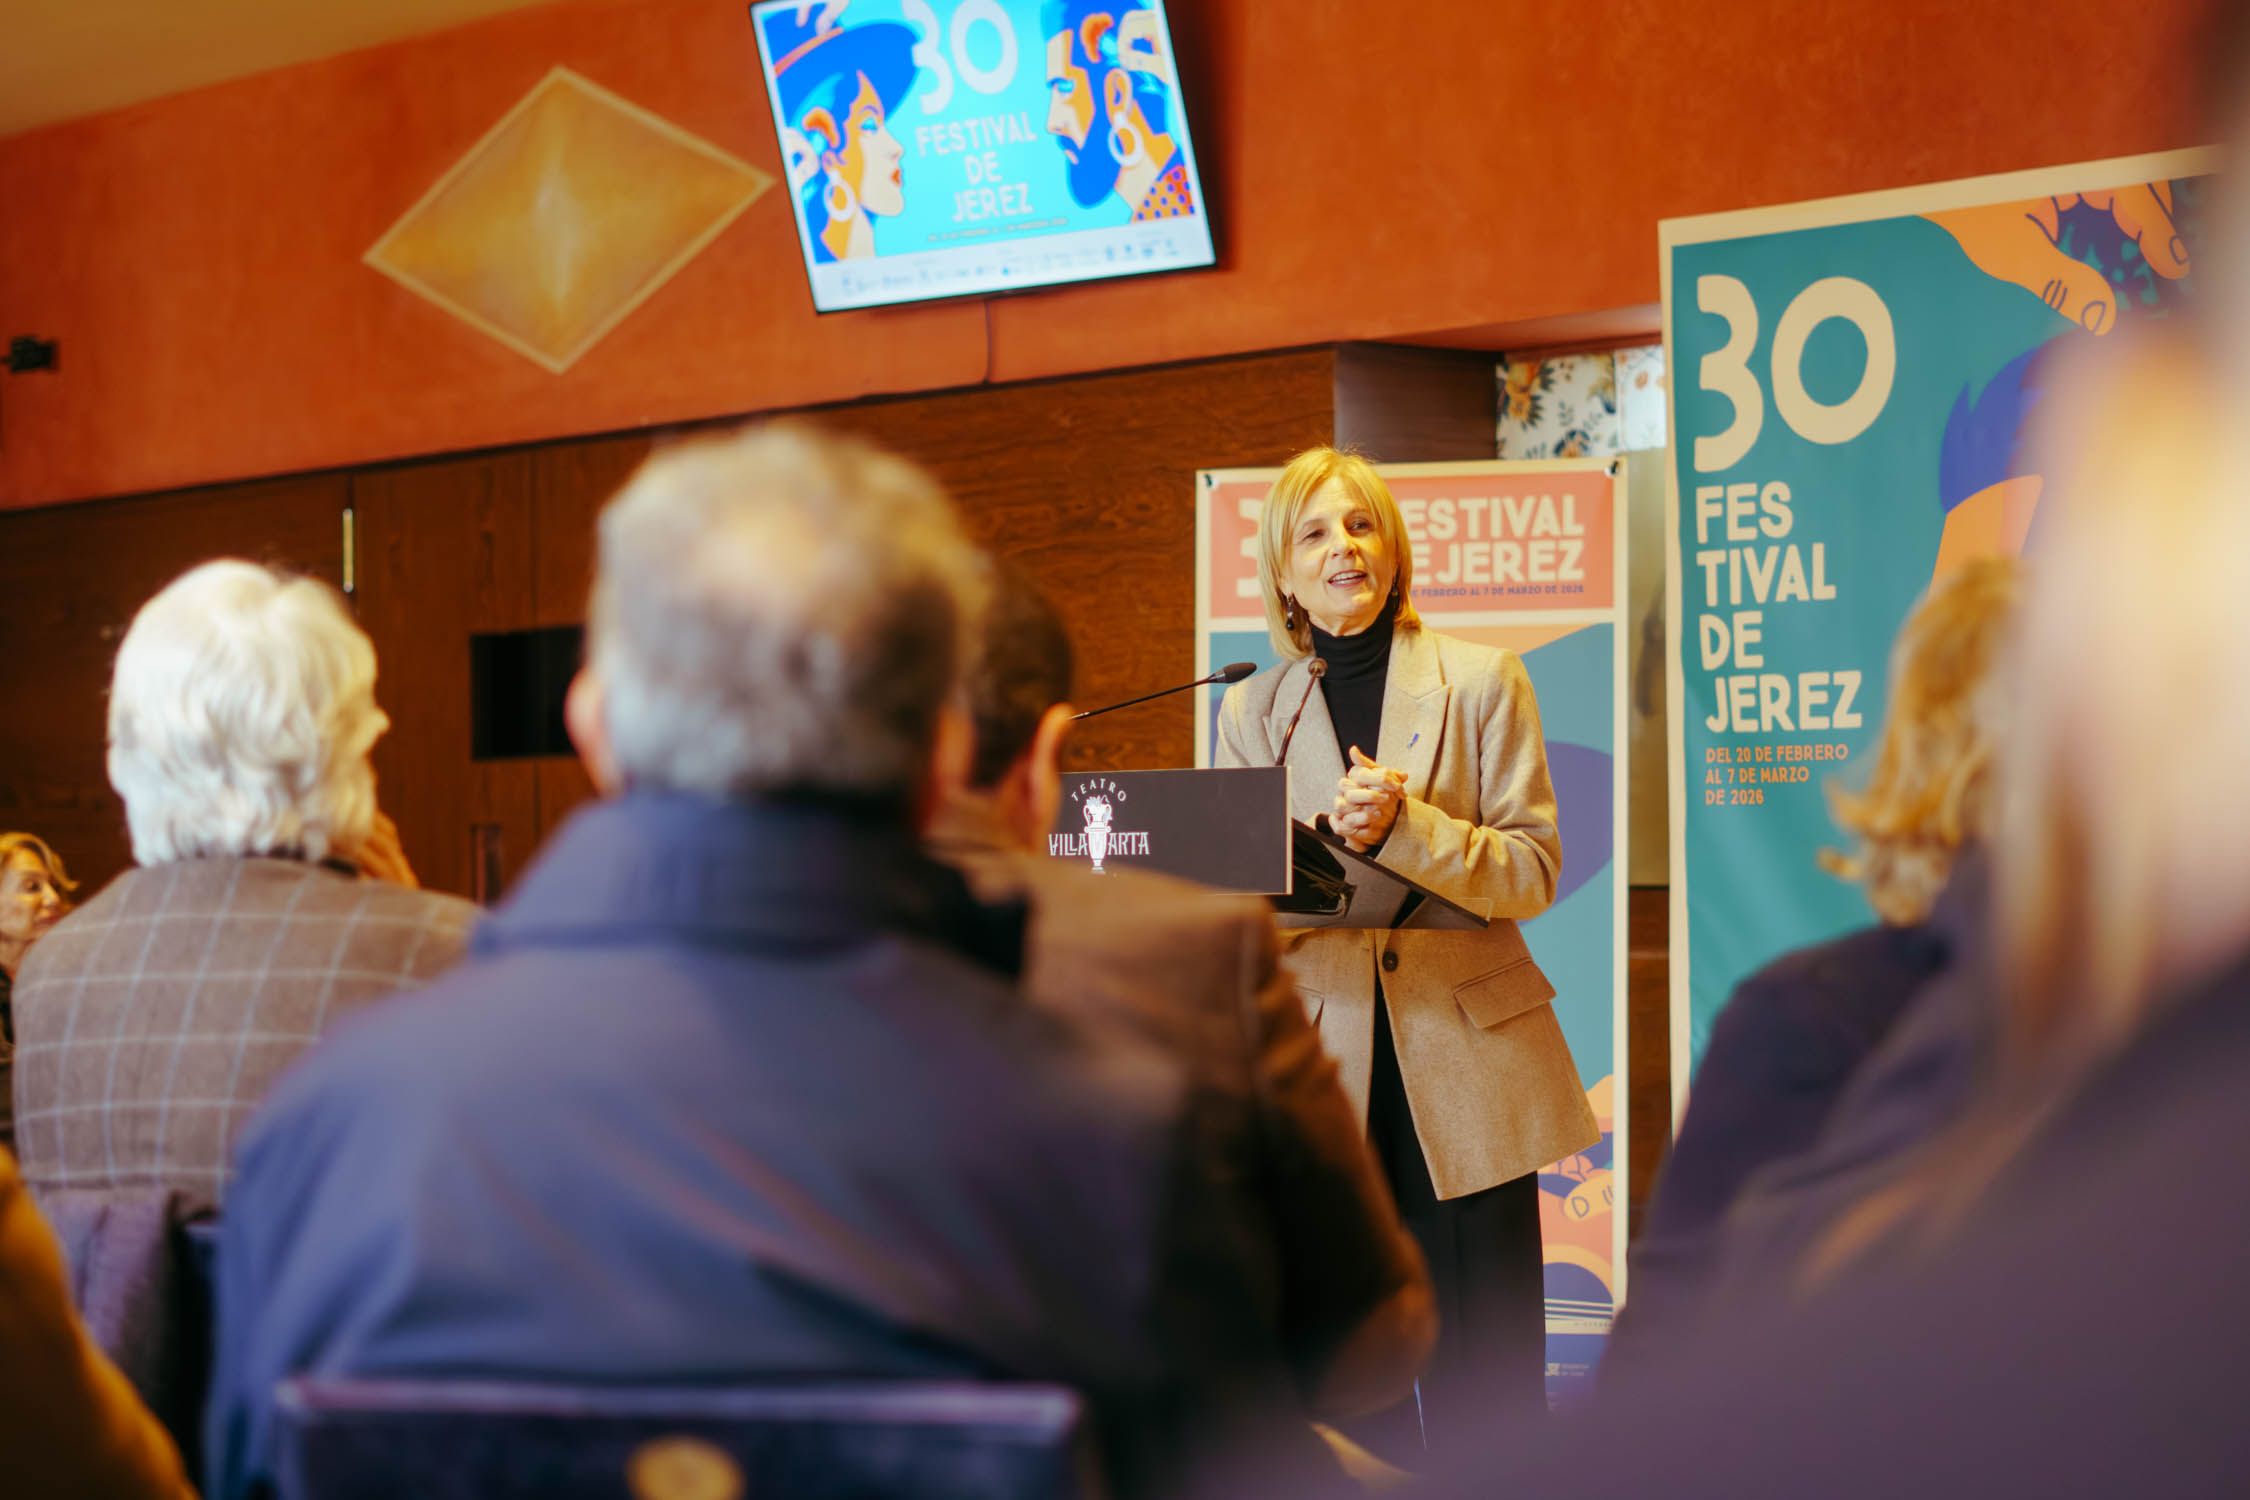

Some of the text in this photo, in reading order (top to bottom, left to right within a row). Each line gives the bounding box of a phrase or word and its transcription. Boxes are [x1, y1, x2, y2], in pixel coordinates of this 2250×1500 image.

[902, 0, 1019, 115] 30
[915, 111, 1037, 157] FESTIVAL
[964, 151, 1002, 185] DE
[952, 182, 1034, 223] JEREZ
[1694, 274, 1896, 472] 30
[1402, 493, 1585, 541] ESTIVAL
[1696, 481, 1793, 544] FES
[1412, 539, 1585, 586] E JEREZ
[1696, 542, 1837, 607] TIVAL
[1421, 587, 1466, 597] FEBRERO
[1492, 587, 1504, 596] DE
[1507, 585, 1541, 595] MARZO
[1545, 584, 1557, 594] DE
[1699, 611, 1764, 671] DE
[1705, 670, 1863, 733] JEREZ
[1705, 744, 1849, 763] DEL 20 DE FEBRERO
[1705, 766, 1810, 785] AL 7 DE MARZO
[1071, 778, 1127, 802] TEATRO
[1705, 788, 1764, 805] DE 2026
